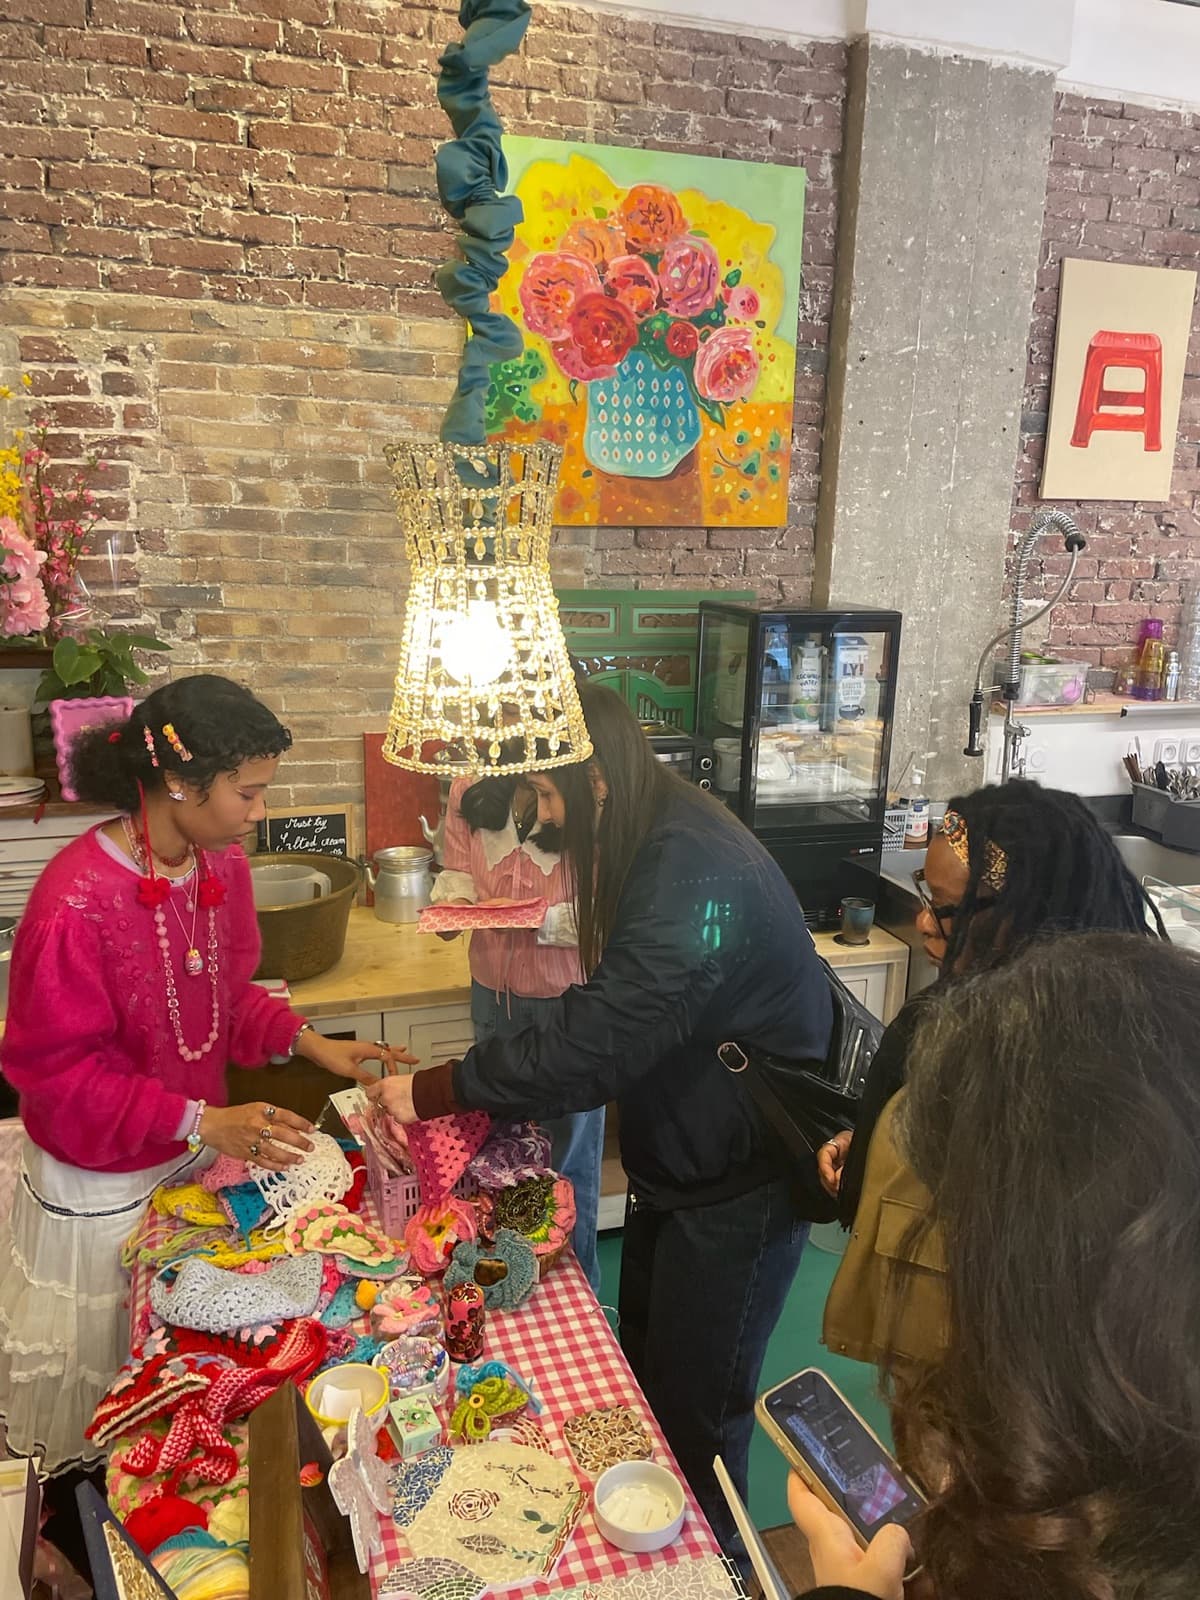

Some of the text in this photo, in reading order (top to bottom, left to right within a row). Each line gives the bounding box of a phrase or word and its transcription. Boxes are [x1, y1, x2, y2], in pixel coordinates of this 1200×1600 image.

[843, 663, 864, 676] LY!
[285, 816, 328, 834] Must try
